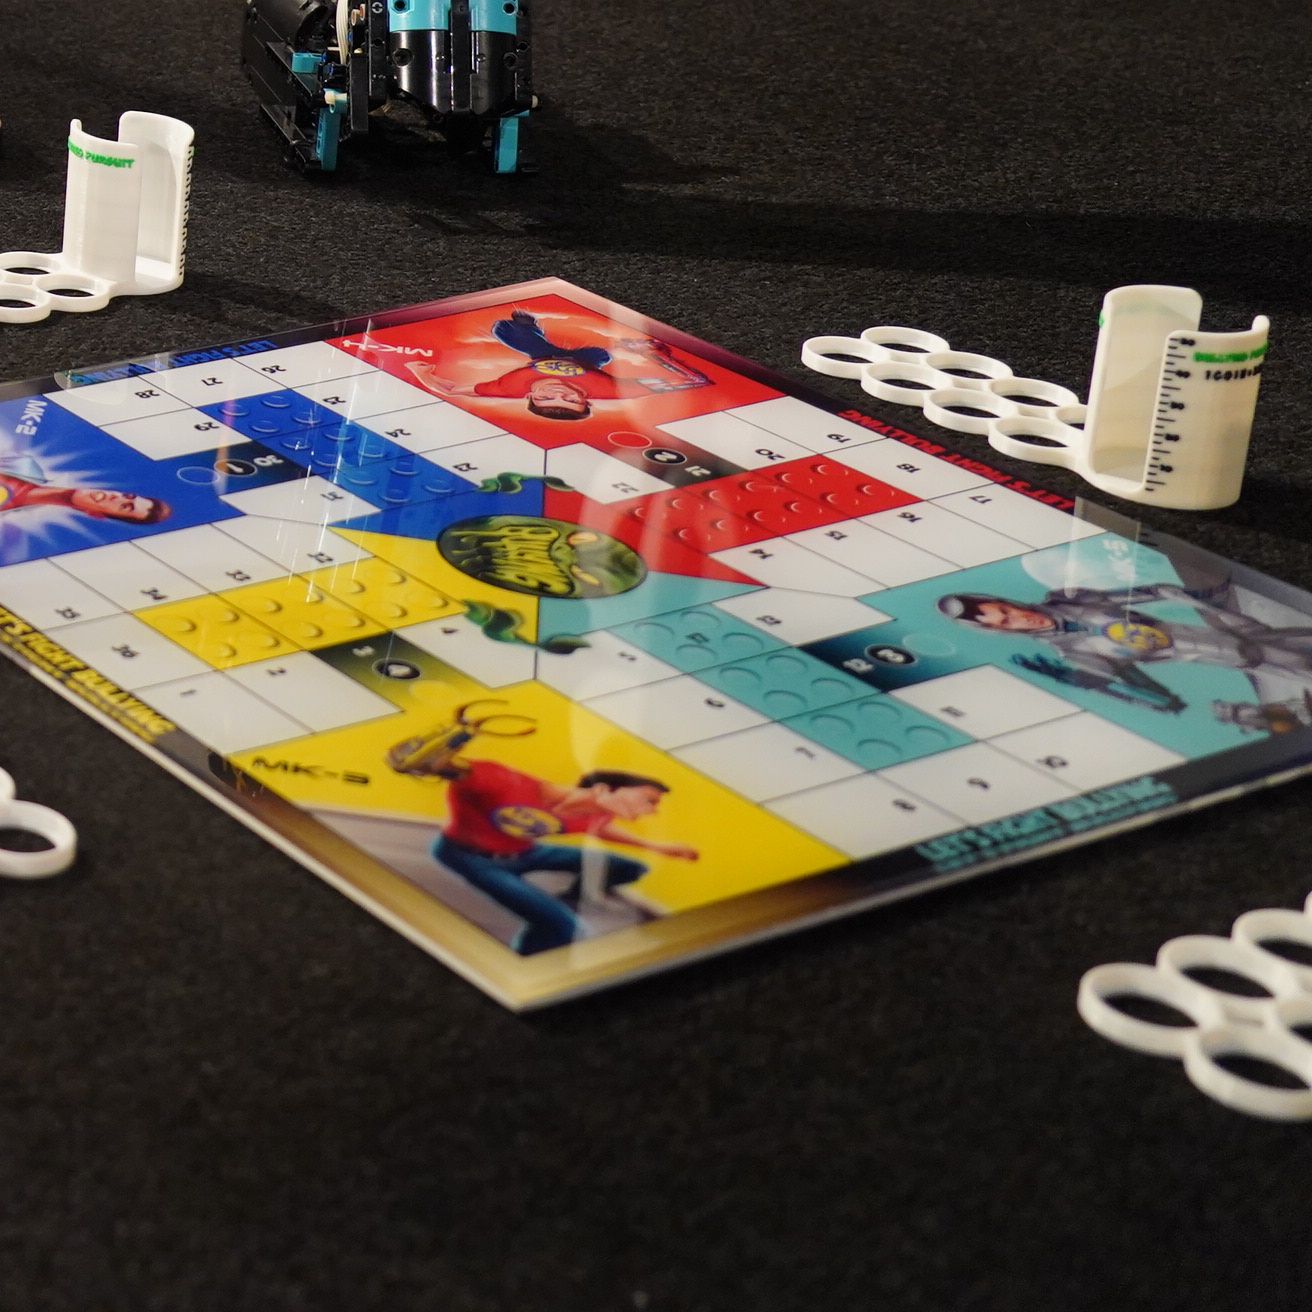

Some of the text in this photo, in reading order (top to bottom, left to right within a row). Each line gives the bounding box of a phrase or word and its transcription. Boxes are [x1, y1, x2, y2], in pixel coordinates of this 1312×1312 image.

[261, 364, 287, 374] 26
[201, 377, 223, 386] 27
[135, 389, 160, 399] 28
[322, 395, 347, 406] 25
[15, 399, 47, 437] MK-2
[194, 421, 219, 433] 29
[386, 427, 412, 438] 24
[837, 409, 947, 455] BULLYING
[827, 433, 851, 443] 19
[756, 448, 785, 461] 20
[253, 454, 283, 468] 30
[452, 460, 479, 473] 23
[683, 464, 712, 478] 21
[896, 463, 920, 474] 18
[612, 481, 639, 493] 22
[321, 491, 344, 503] 31
[969, 495, 992, 504] 17
[896, 511, 923, 523] 16
[826, 529, 849, 540] 15
[308, 551, 333, 565] 32
[748, 547, 774, 559] 14
[488, 524, 570, 596] BULLYING
[226, 569, 252, 583] 33
[141, 588, 168, 601] 34
[56, 607, 81, 620] 35
[267, 666, 287, 676] 2
[25, 633, 87, 671] FIGHT
[71, 669, 176, 737] BULLYING
[1037, 755, 1069, 769] 10
[893, 798, 916, 812] 8
